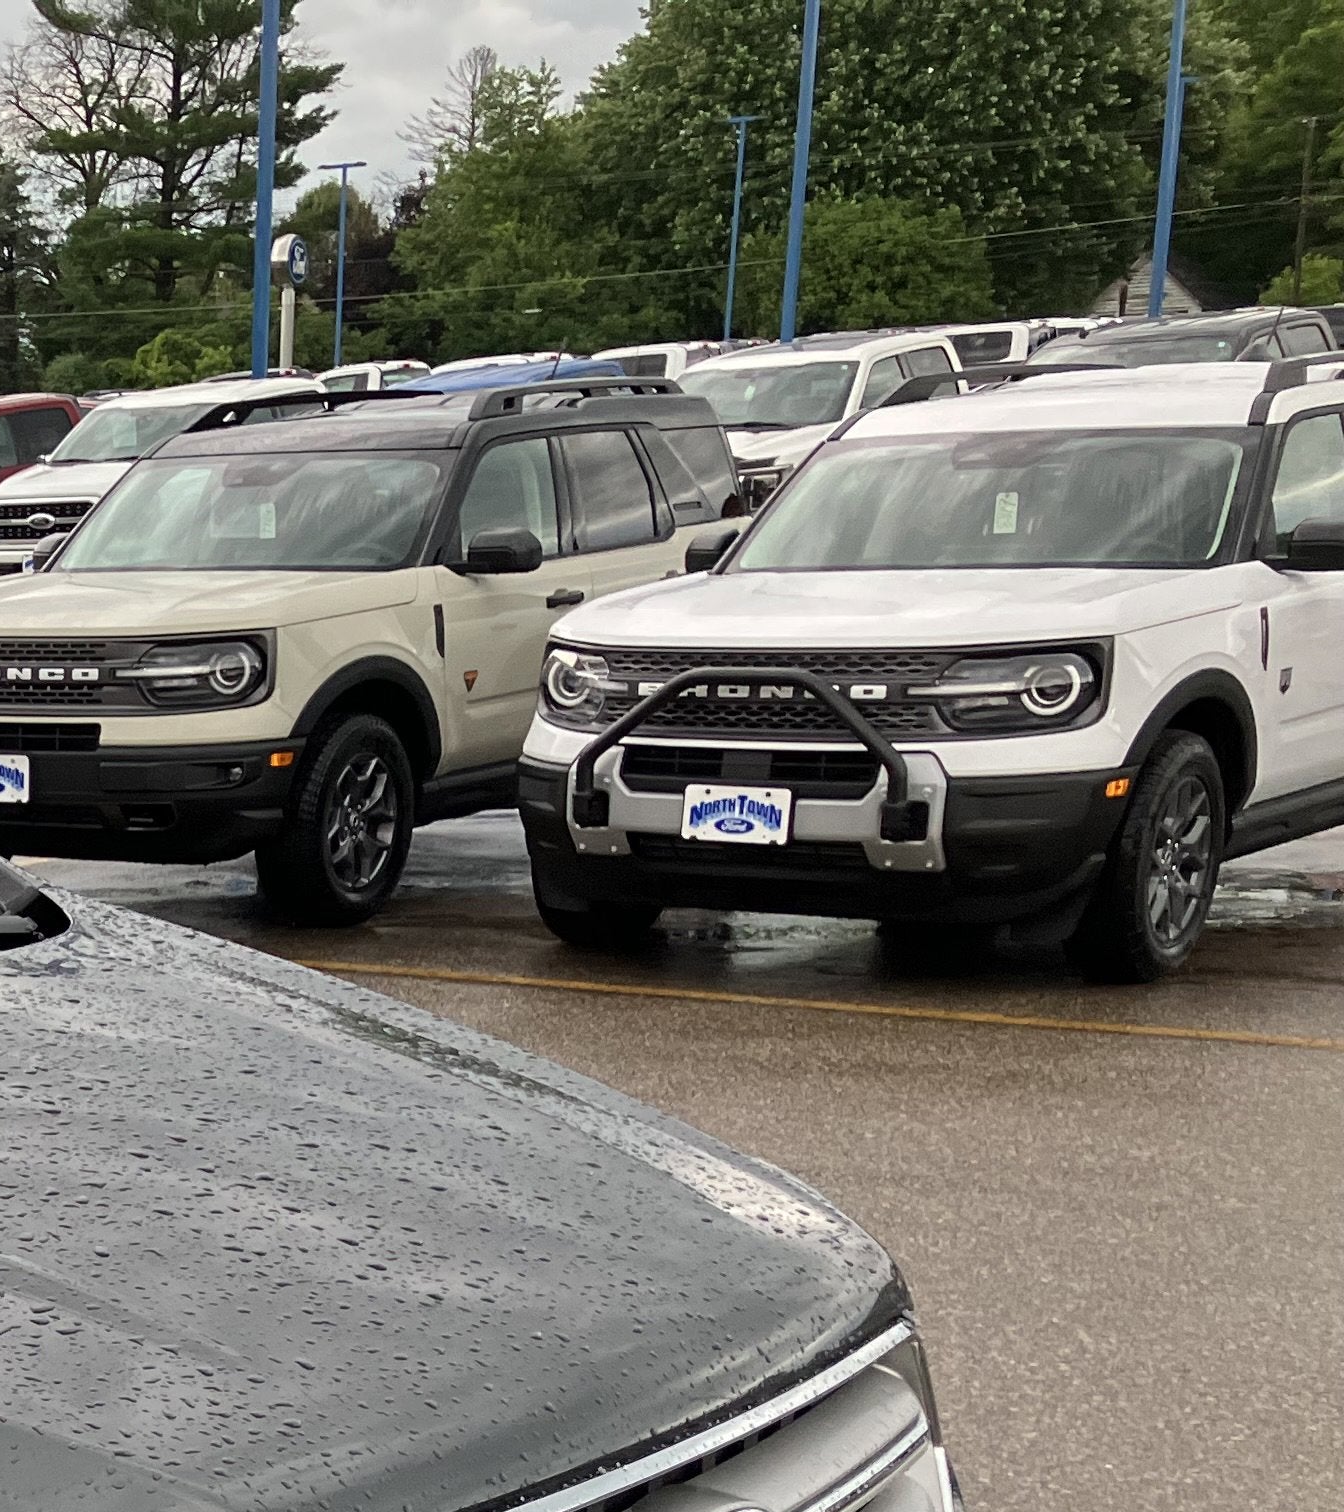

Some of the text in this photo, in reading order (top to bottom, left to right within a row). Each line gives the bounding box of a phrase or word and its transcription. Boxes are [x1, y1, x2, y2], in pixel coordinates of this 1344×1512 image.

[638, 682, 887, 699] BRONO
[689, 795, 782, 829] NORTH TOWN
[720, 818, 749, 832] Ford
